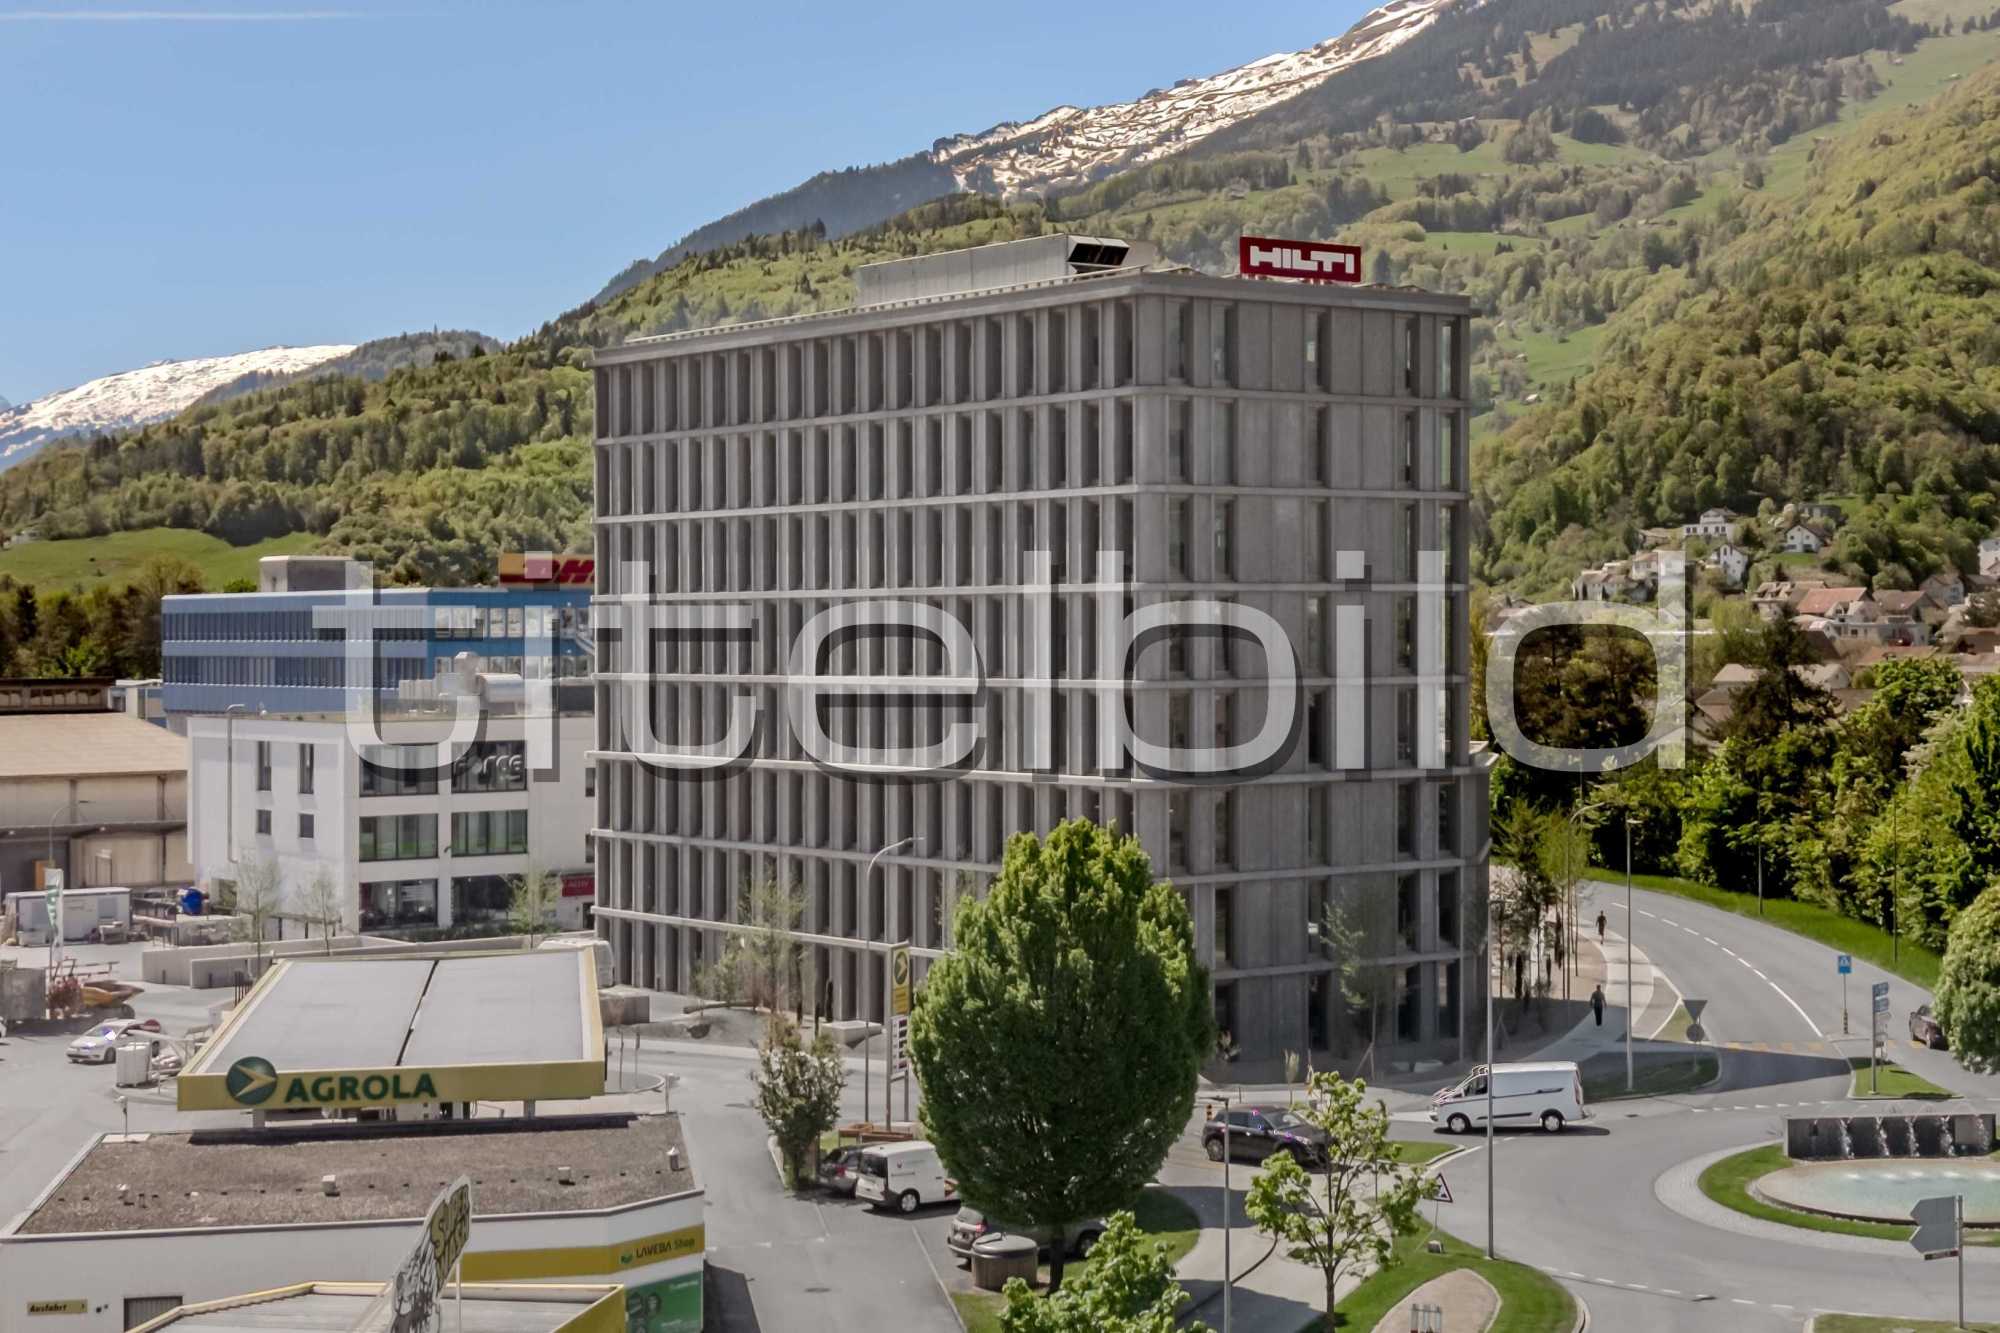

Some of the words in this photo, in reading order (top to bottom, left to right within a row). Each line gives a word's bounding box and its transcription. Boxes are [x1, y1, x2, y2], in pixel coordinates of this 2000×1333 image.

[1249, 245, 1355, 275] HILTI
[284, 1073, 438, 1104] AGROLA
[30, 1303, 67, 1313] Ausfahrt
